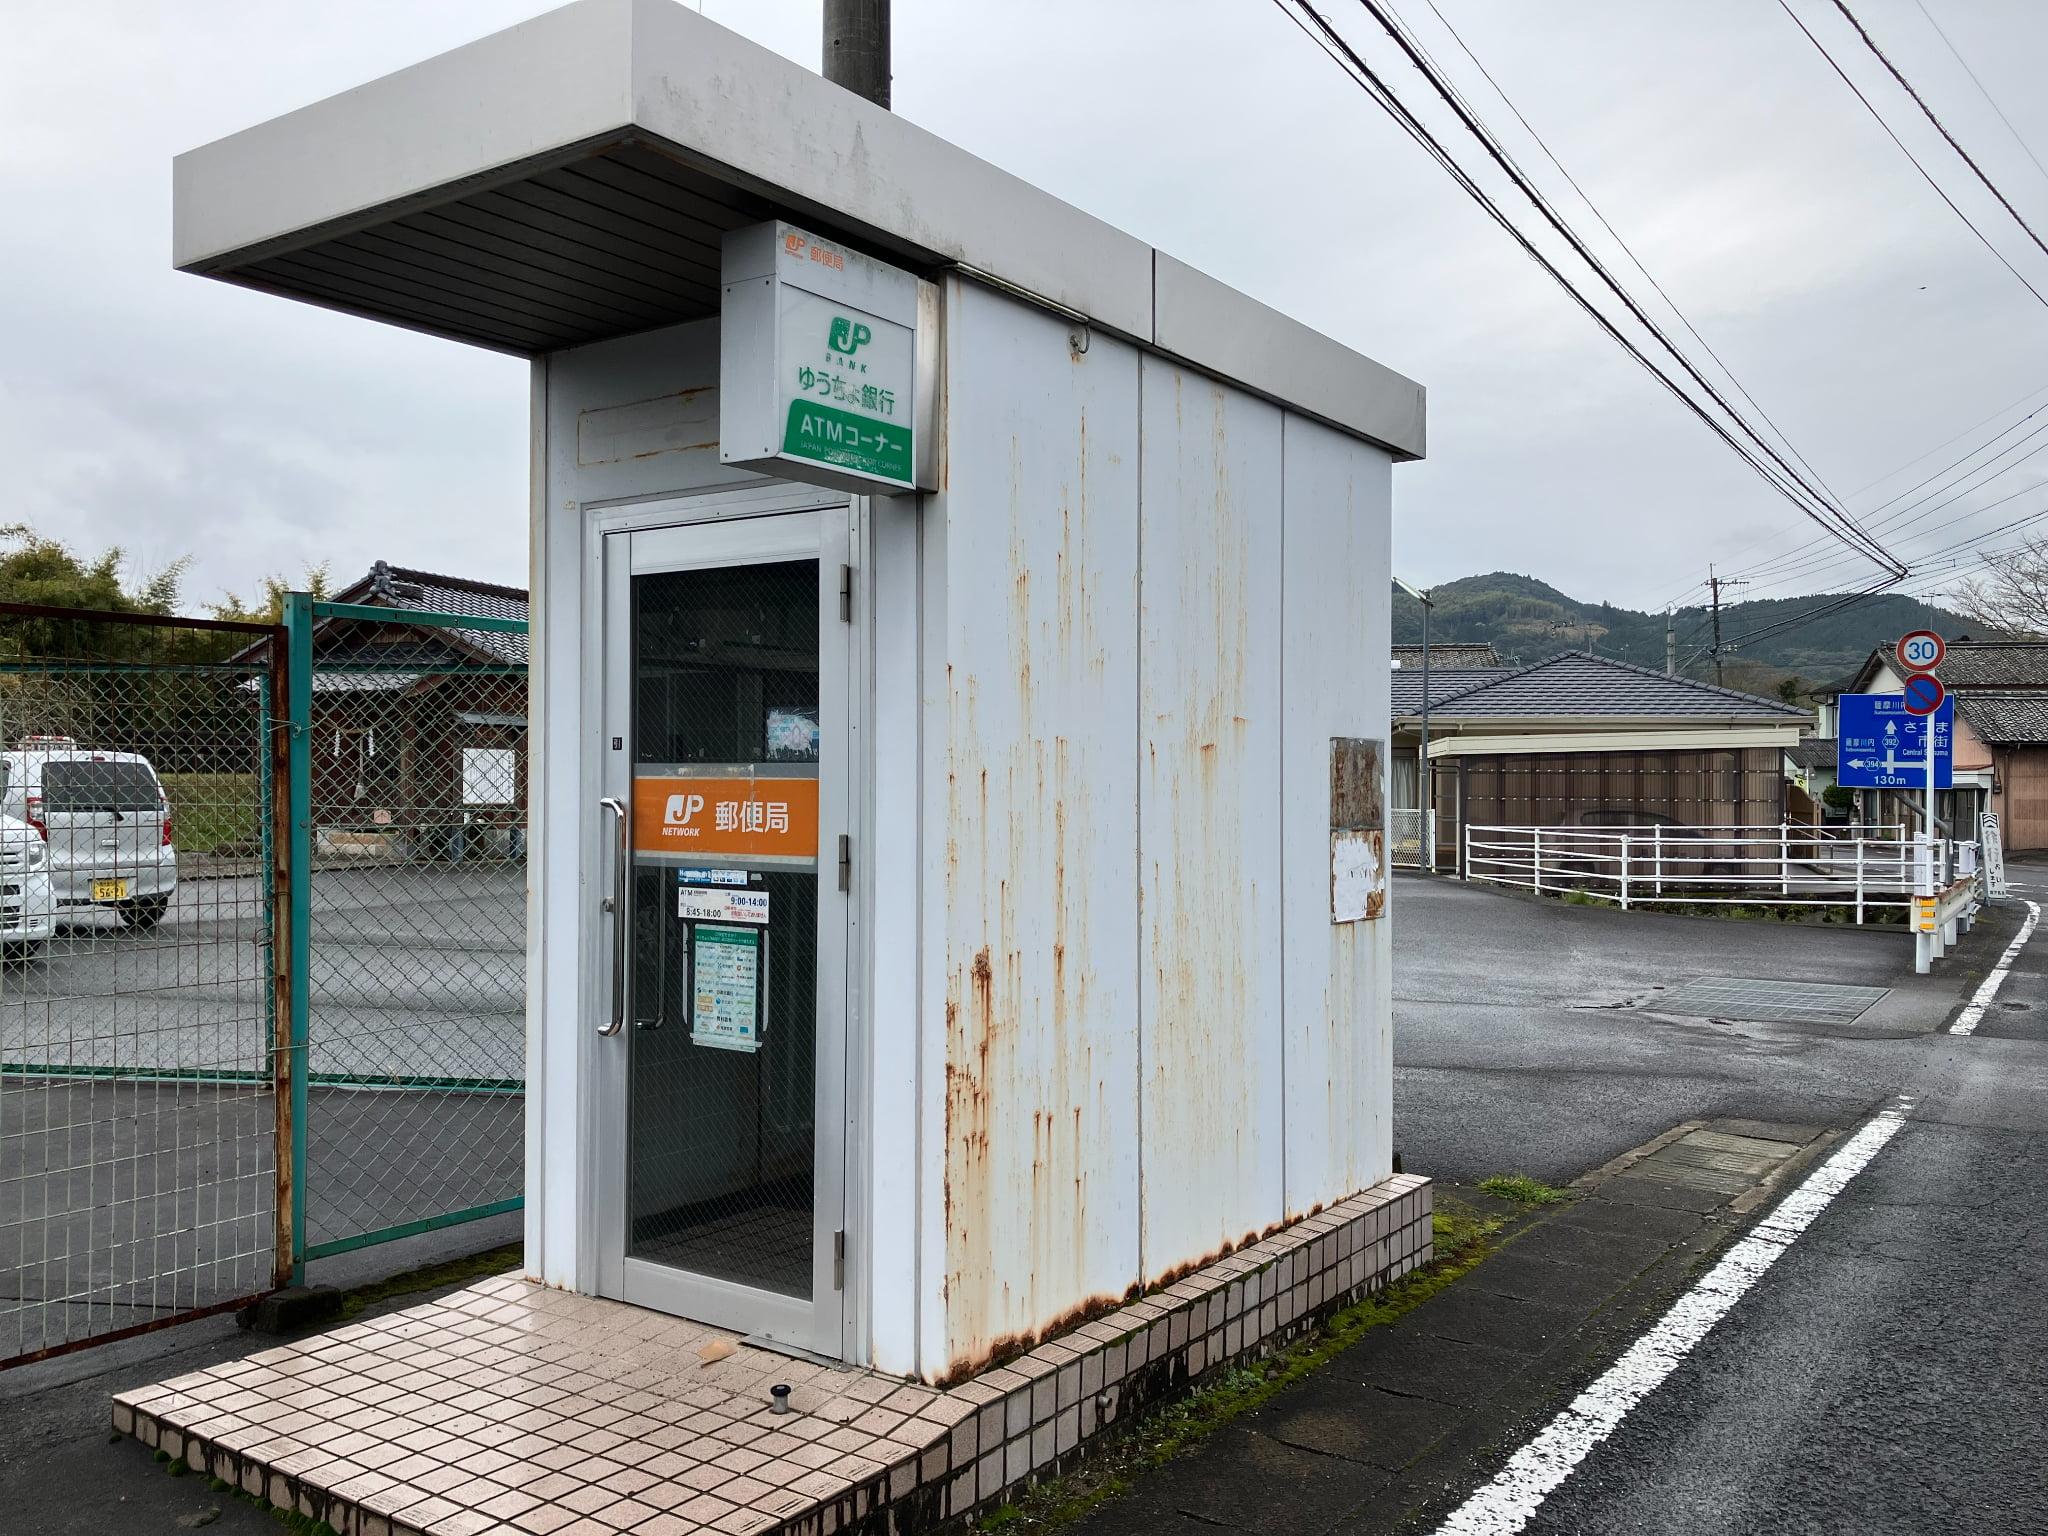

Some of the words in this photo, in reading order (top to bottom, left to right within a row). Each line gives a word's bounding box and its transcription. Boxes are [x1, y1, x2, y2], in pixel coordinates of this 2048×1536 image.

[810, 246, 844, 272] 郵便局
[828, 316, 872, 355] JP
[825, 352, 868, 374] BANK
[798, 366, 895, 416] ゆうちょ銀行
[800, 413, 903, 453] ATMコーナー
[1908, 641, 1935, 660] 30
[1902, 748, 1922, 756] Central
[1866, 760, 1879, 768] 394
[1874, 775, 1906, 785] 130m
[664, 794, 705, 825] JP
[715, 800, 789, 834] 郵便局
[662, 827, 700, 837] NETWORK
[730, 896, 768, 907] 9:00-14:00
[686, 907, 722, 918] 8:45-18:00
